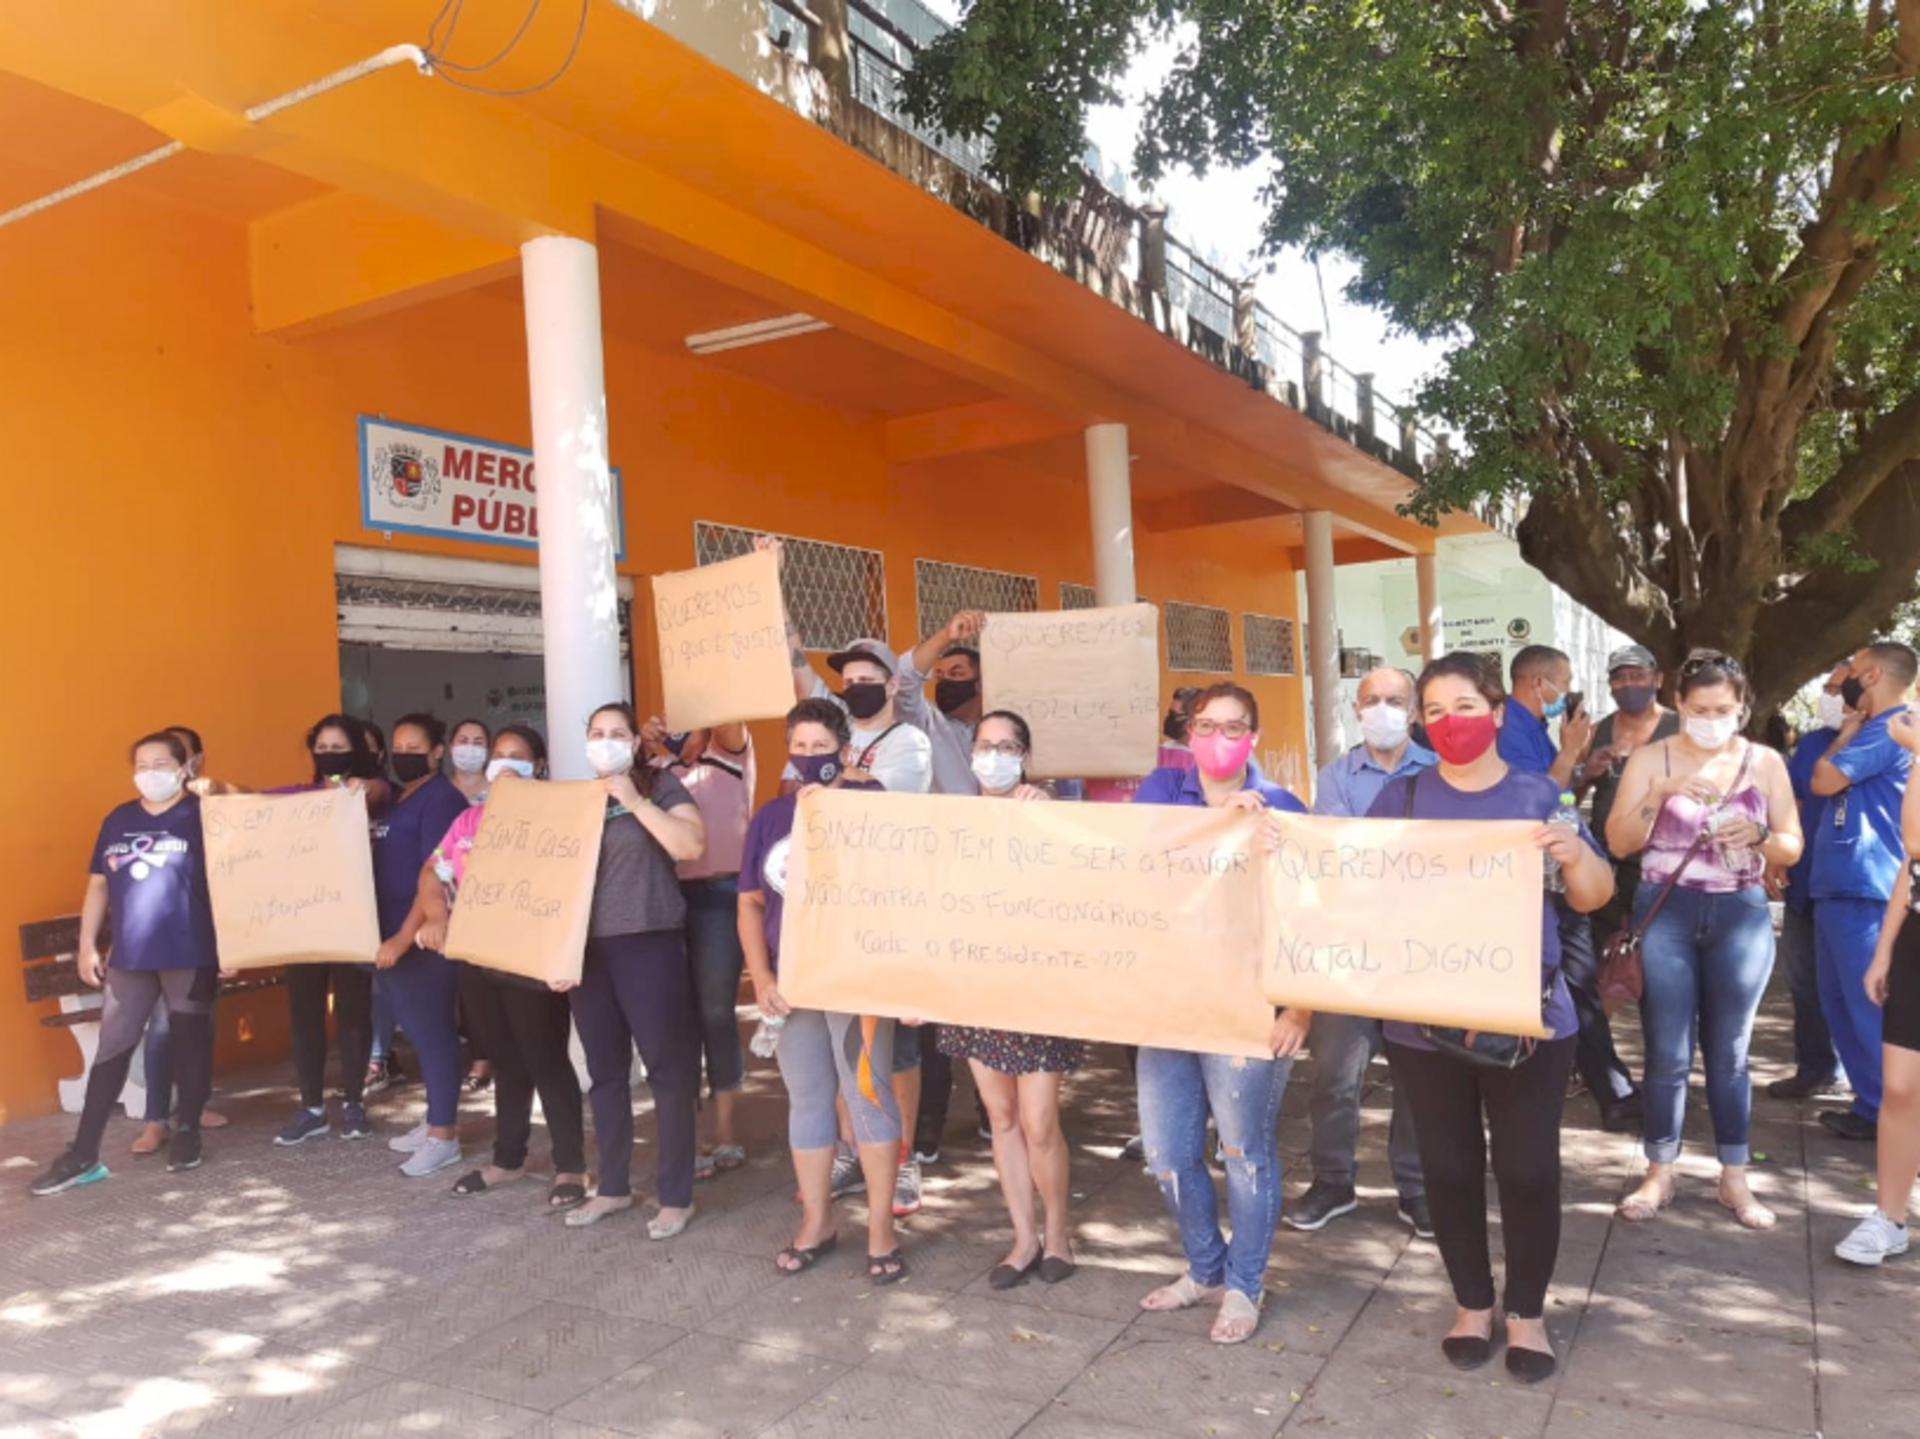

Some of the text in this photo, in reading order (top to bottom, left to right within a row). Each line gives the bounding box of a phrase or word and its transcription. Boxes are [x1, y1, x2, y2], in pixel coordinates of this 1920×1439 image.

[442, 445, 537, 493] MERC
[451, 489, 539, 537] PÚBL
[658, 580, 762, 631] QUEREMOS
[662, 645, 675, 670] O
[680, 638, 709, 671] QUE
[728, 625, 785, 660] JUSTO
[989, 615, 1145, 664] QUEREMOS
[205, 807, 274, 839] QUEM
[949, 826, 995, 862] TEM
[1008, 835, 1057, 874] QUE
[1069, 843, 1127, 872] SER
[1278, 837, 1514, 884] QUEREMOS UM
[940, 891, 976, 915] OS
[1402, 938, 1514, 975] DIGNO
